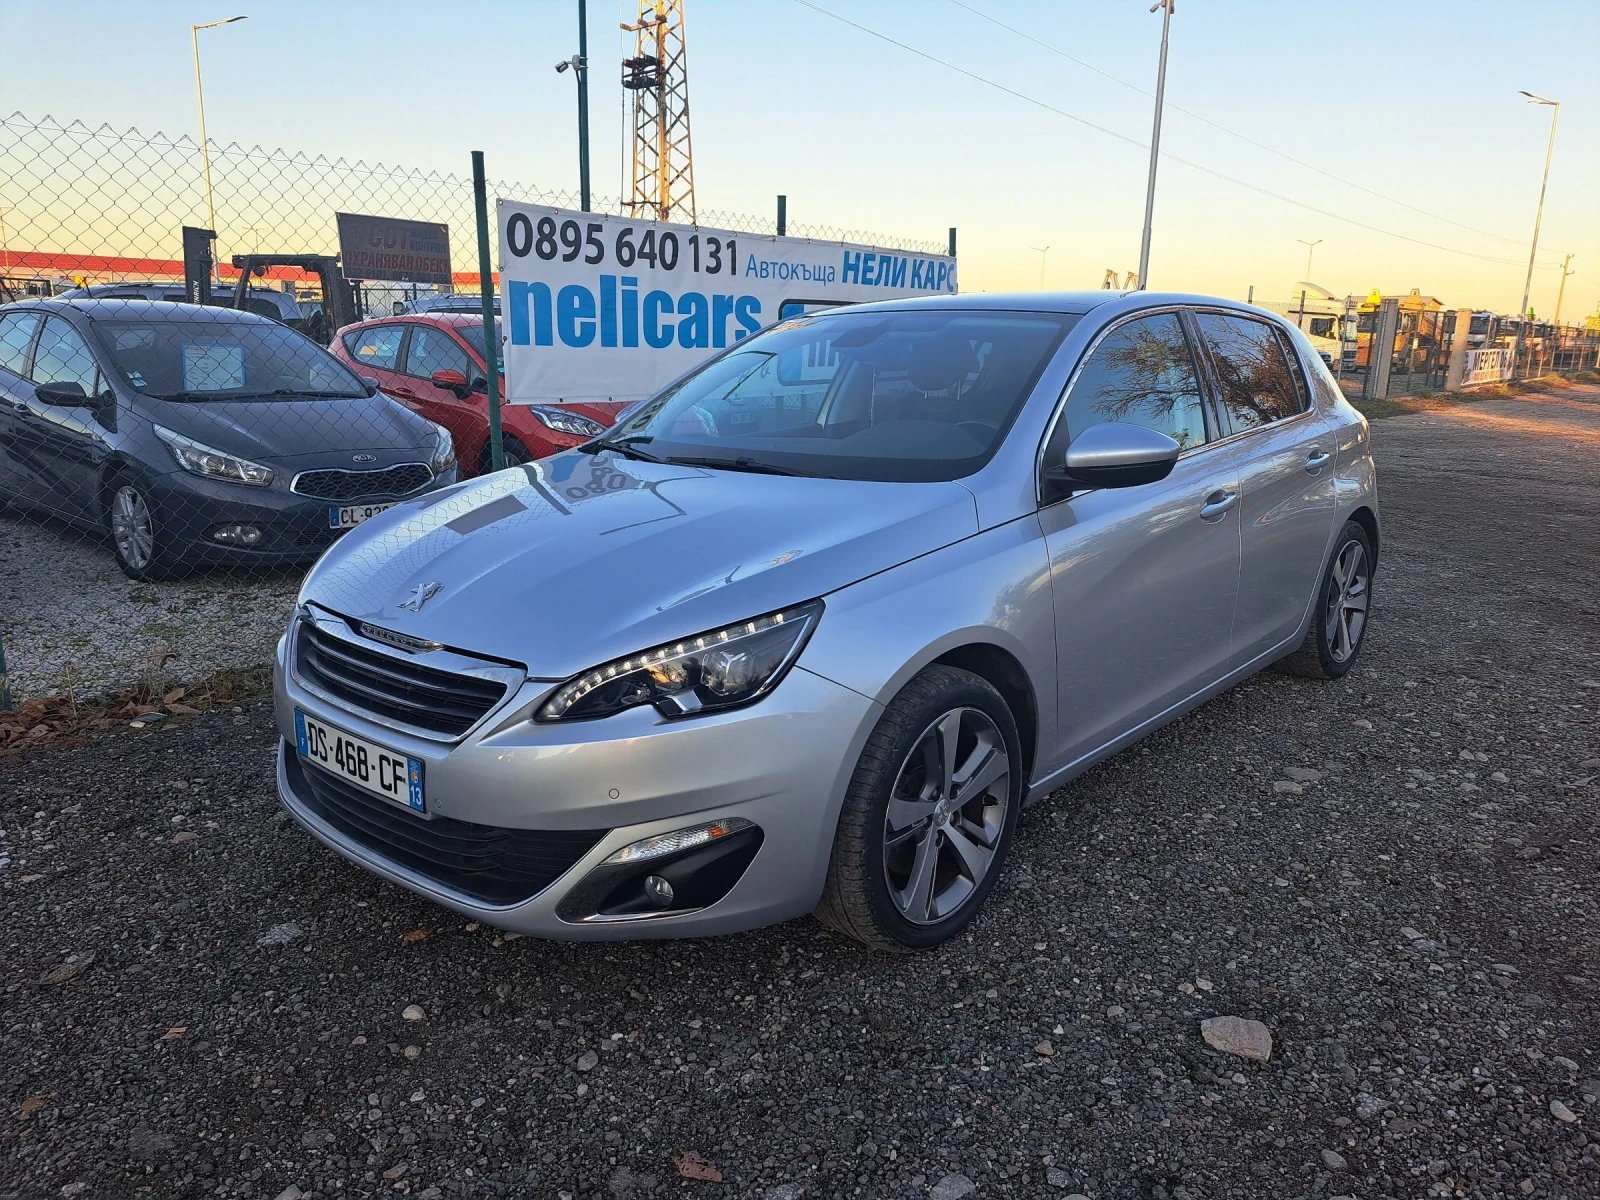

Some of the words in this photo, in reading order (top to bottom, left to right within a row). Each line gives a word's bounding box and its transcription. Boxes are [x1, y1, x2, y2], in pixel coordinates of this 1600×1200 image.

[410, 240, 447, 254] КОНТРОЛ
[506, 212, 605, 265] 0895
[615, 227, 679, 271] 640
[688, 234, 737, 276] 131
[345, 250, 414, 271] ОХРАНЯВАН
[745, 253, 835, 286] Автокъща
[841, 250, 908, 288] НЕЛИ
[910, 258, 955, 293] КАРС
[509, 274, 761, 349] nelicars
[410, 785, 422, 806] 13
